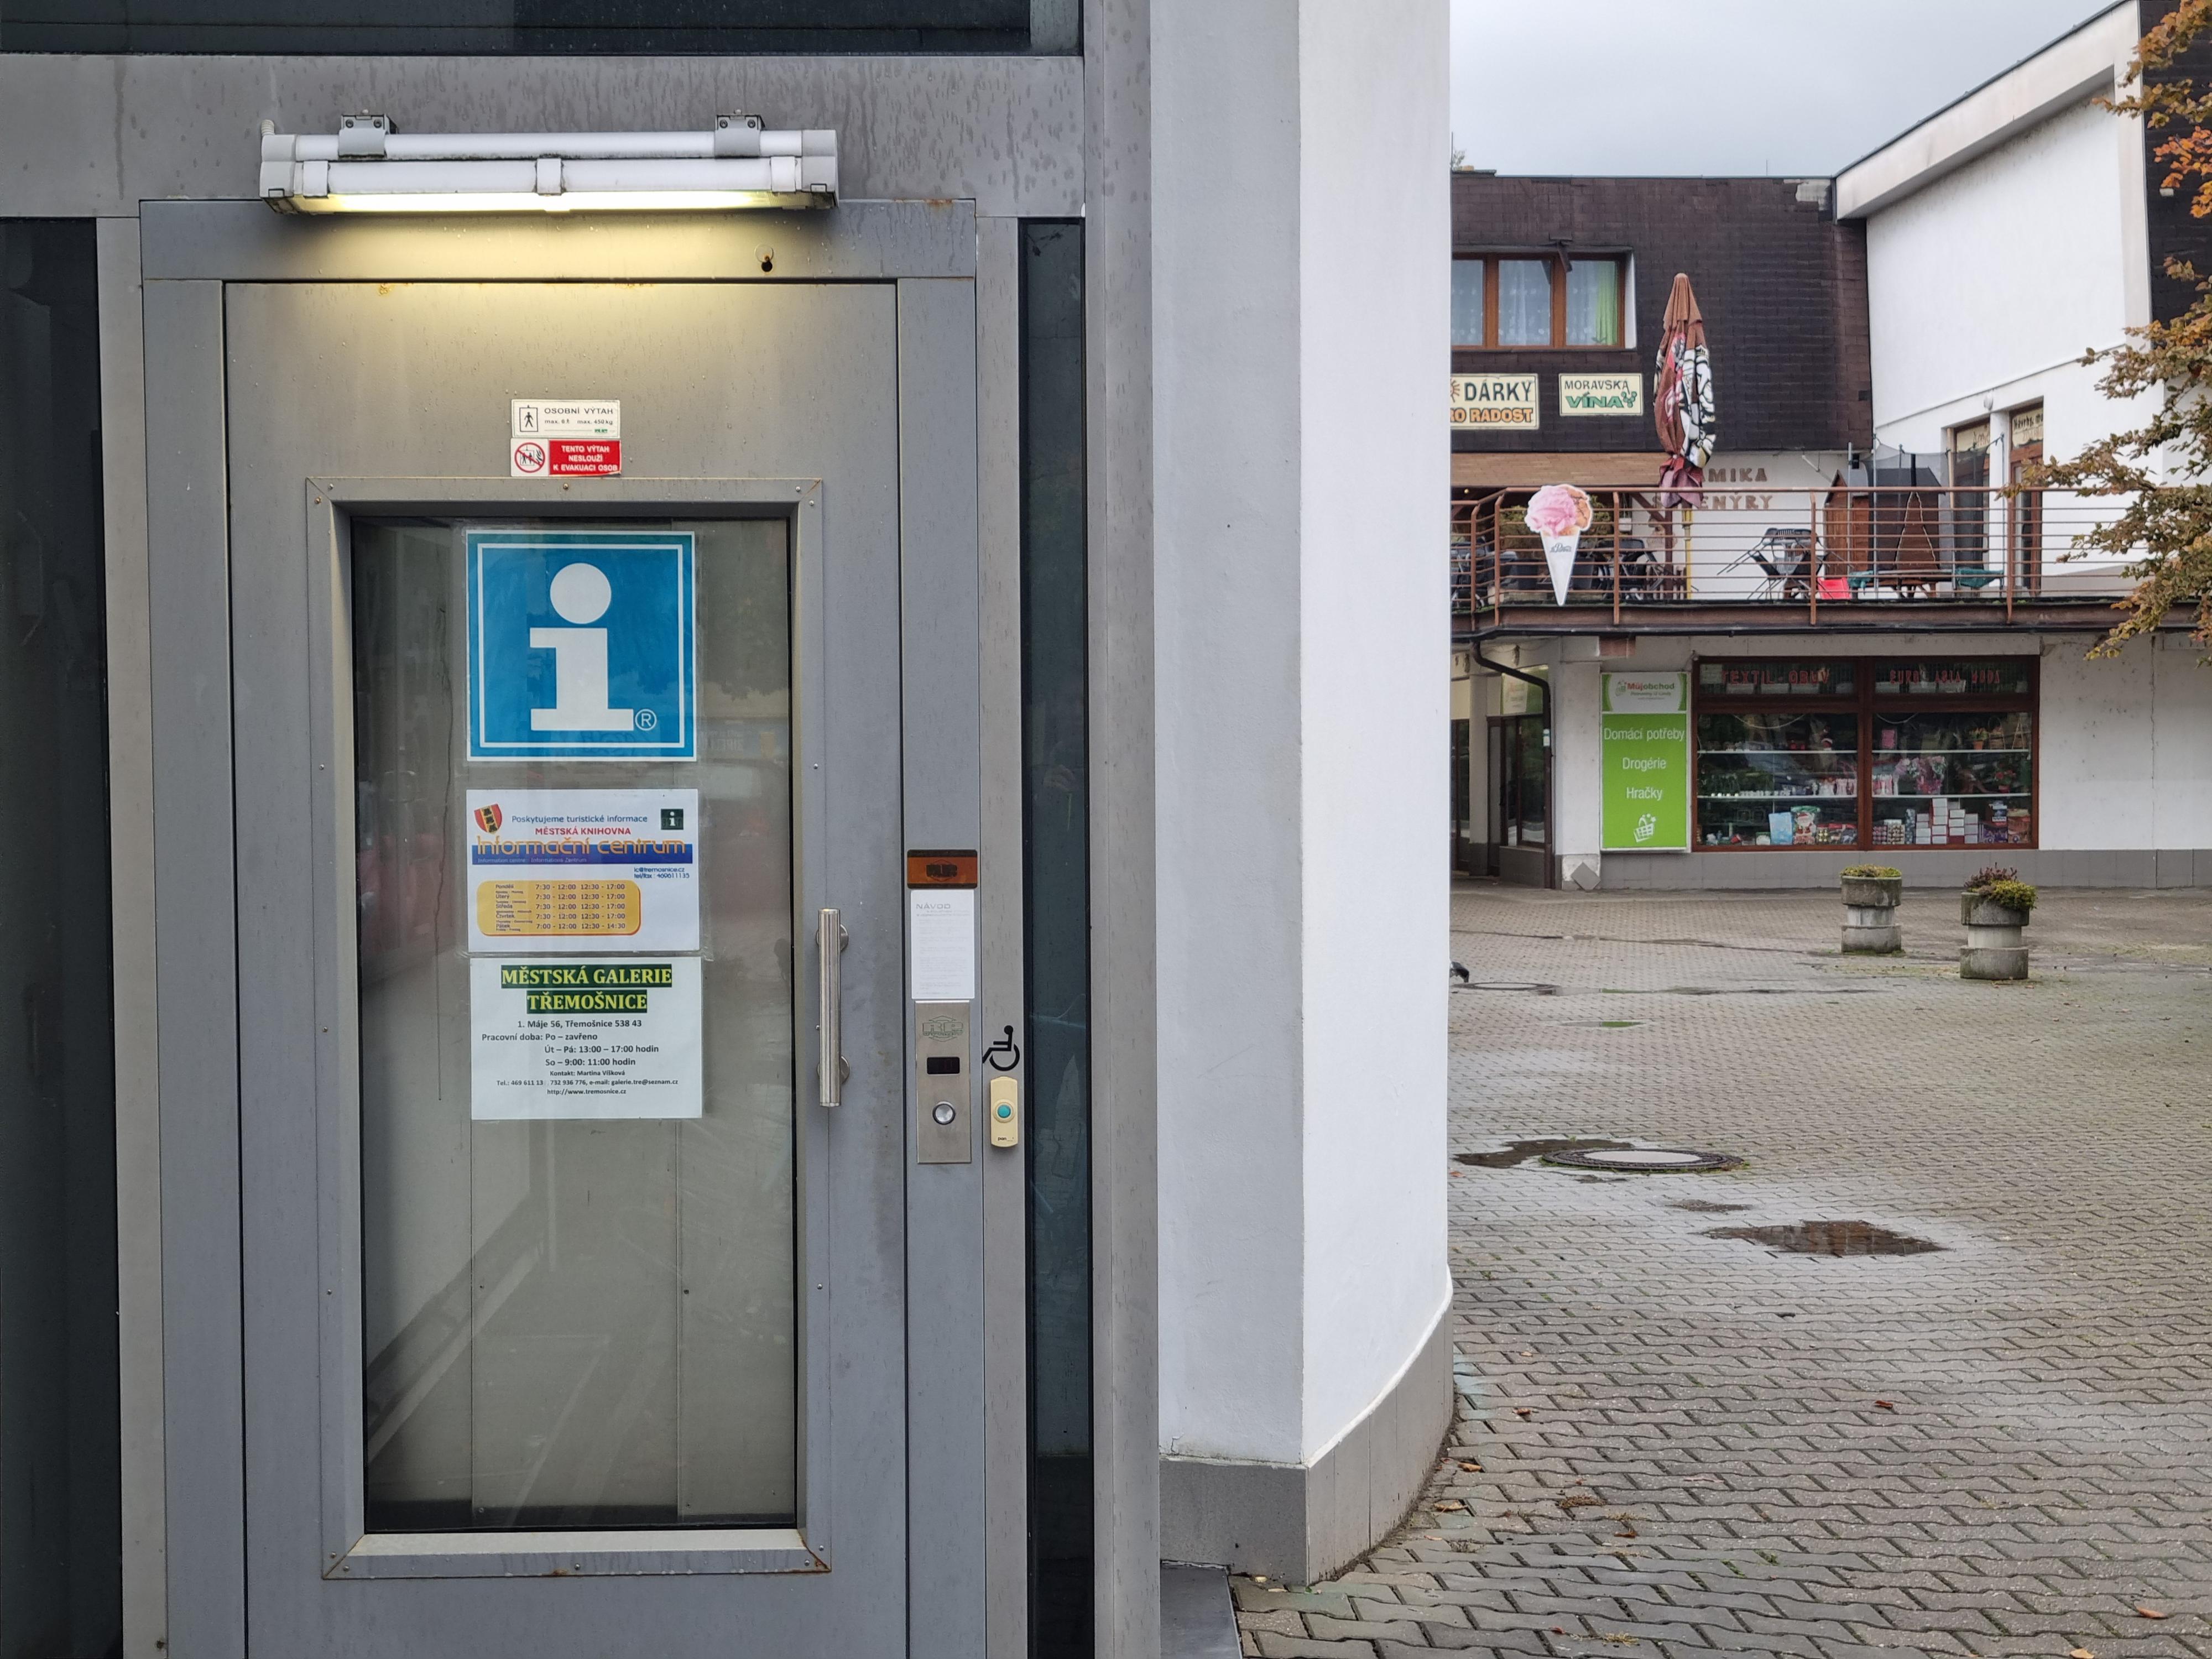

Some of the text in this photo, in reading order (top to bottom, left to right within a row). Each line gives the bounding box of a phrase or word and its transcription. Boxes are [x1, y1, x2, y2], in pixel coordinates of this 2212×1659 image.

[1464, 379, 1532, 401] DÁRKY
[1566, 392, 1624, 408] VÍNA
[584, 406, 613, 415] VÝTAH
[1470, 408, 1533, 423] RADOST
[587, 444, 609, 452] VÝTAH
[568, 453, 603, 462] NESLOUŽÍ
[1604, 727, 1684, 742] Domácí potřeby
[1623, 757, 1667, 772] Drogérie
[1626, 786, 1663, 801] Hračky
[535, 826, 578, 835] MĚSTSKÁ
[597, 837, 686, 854] centrum
[502, 966, 672, 984] MĚSTSKÁ GALERIE
[527, 991, 647, 1010] TŘEMOŠNICE
[528, 1020, 548, 1029] Máje
[551, 1020, 563, 1029] 56,
[545, 1045, 554, 1053] Út
